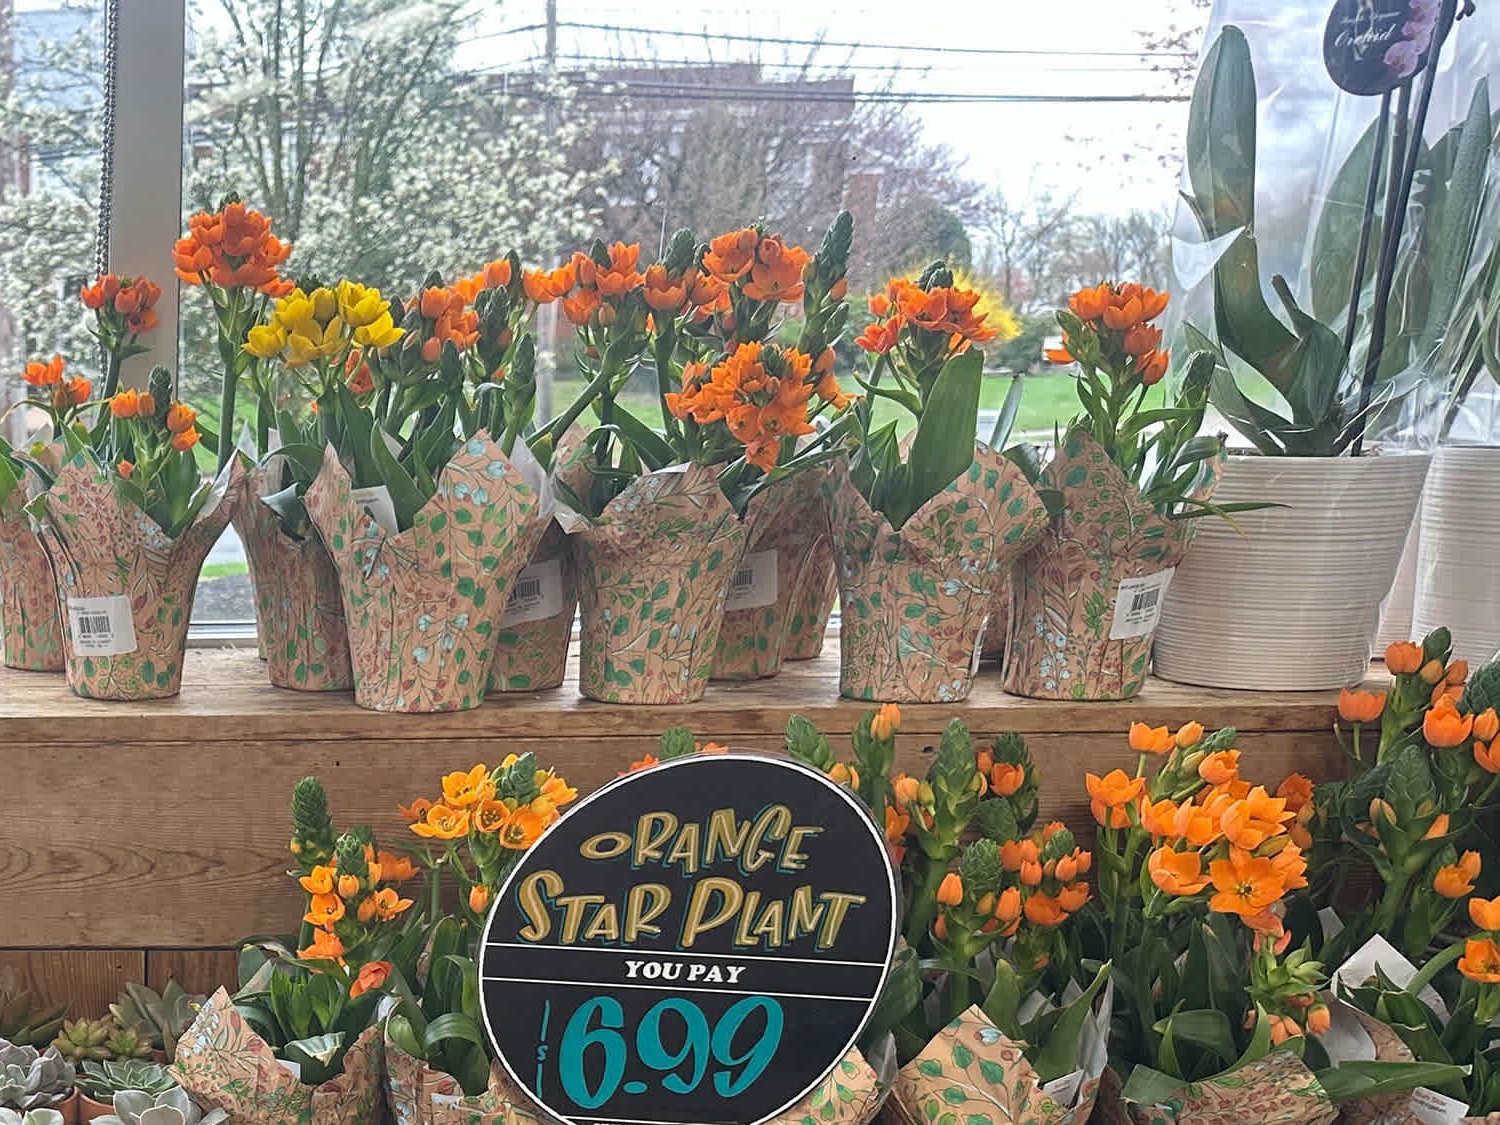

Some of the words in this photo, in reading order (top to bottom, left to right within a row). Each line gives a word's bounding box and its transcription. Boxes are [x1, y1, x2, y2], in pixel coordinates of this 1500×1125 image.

[580, 804, 825, 876] ORANGE
[516, 870, 672, 946] STAR
[677, 876, 867, 951] PLANT
[625, 960, 683, 980] YOU
[686, 964, 746, 983] PAY
